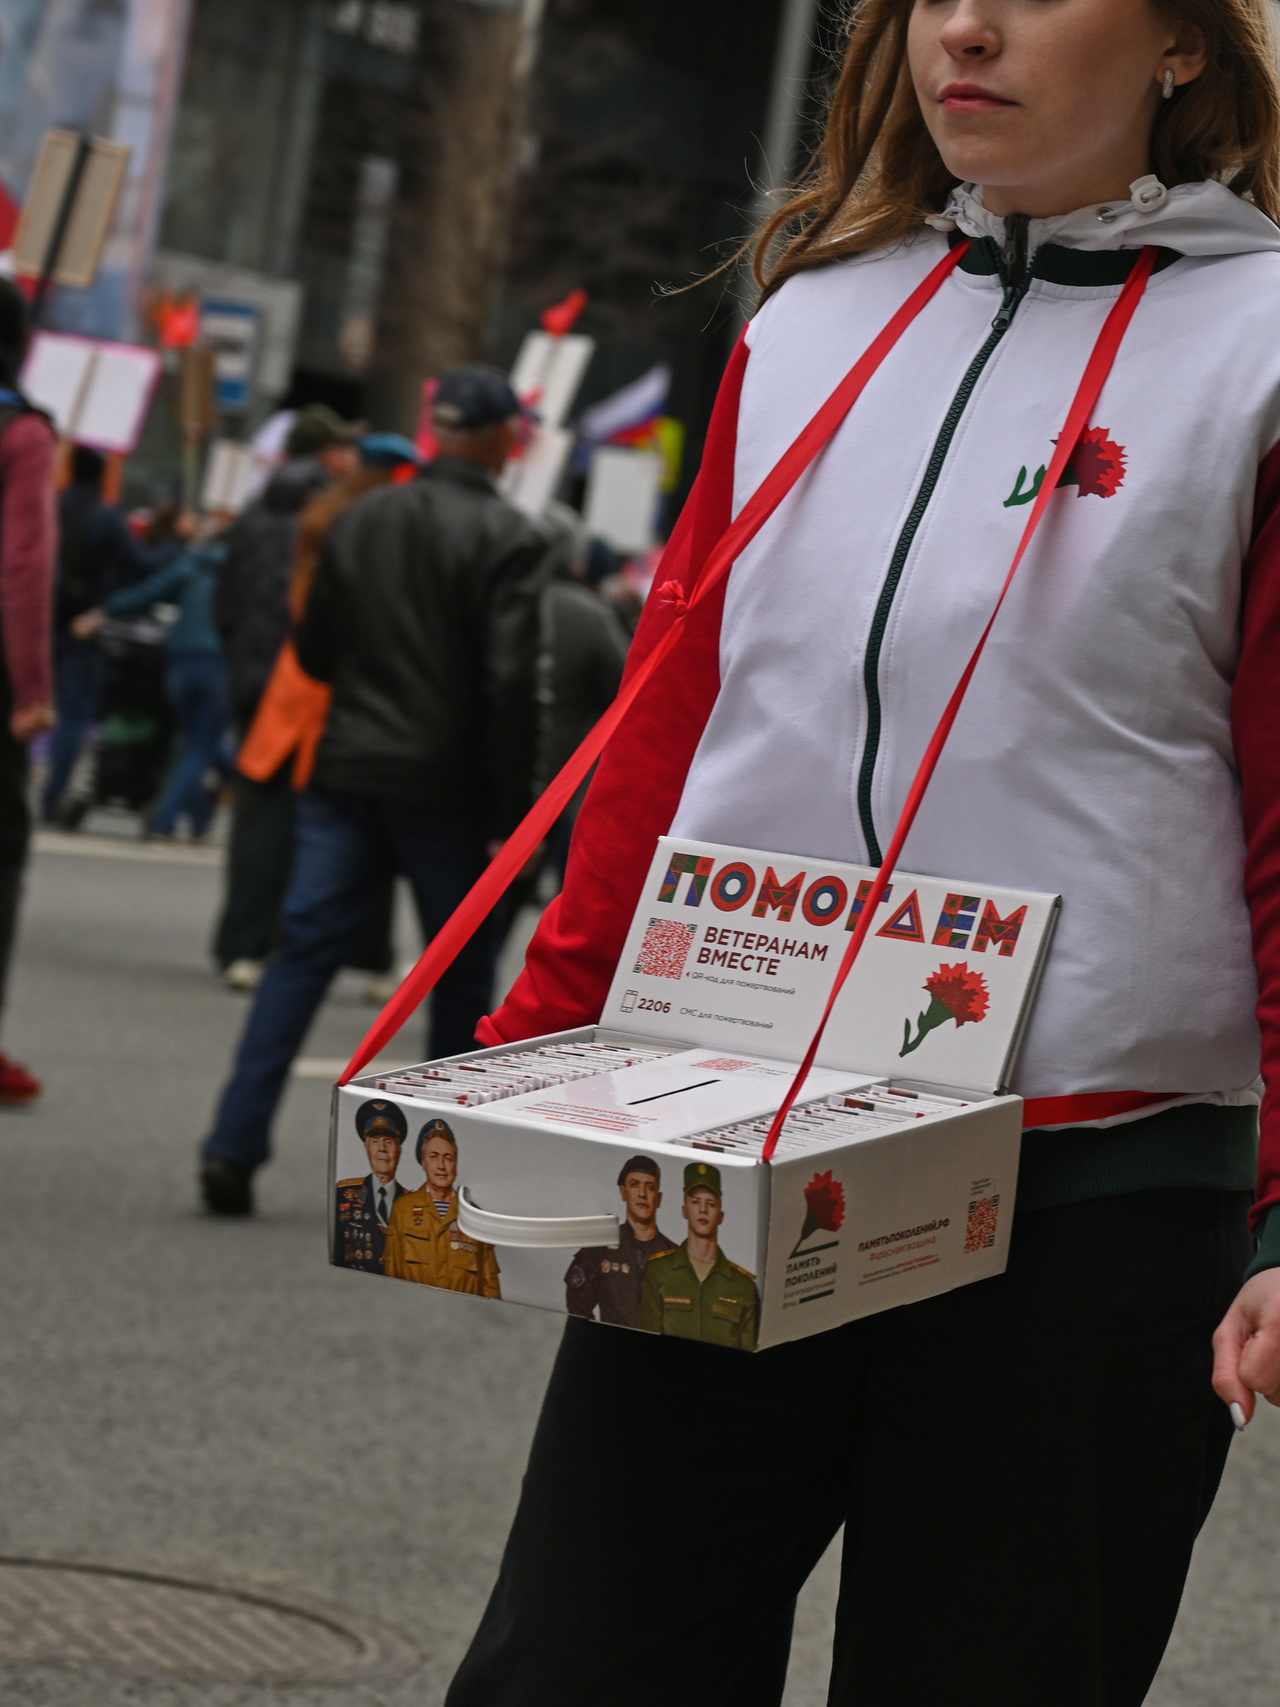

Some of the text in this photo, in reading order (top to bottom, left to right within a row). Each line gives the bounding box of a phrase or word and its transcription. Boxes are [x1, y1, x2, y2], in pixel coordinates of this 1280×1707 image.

[703, 926, 829, 962] ВЕТЕРАНАМ
[697, 947, 781, 976] ВМЕСТЕ
[637, 997, 672, 1014] 2206
[679, 1007, 699, 1018] СМС
[858, 1218, 950, 1252] ПАМЯТЬПОКОЛЕНИЙ.РФ
[785, 1262, 838, 1288] ПОКОЛЕНИЙ
[786, 1256, 821, 1274] ПАМЯТЬ
